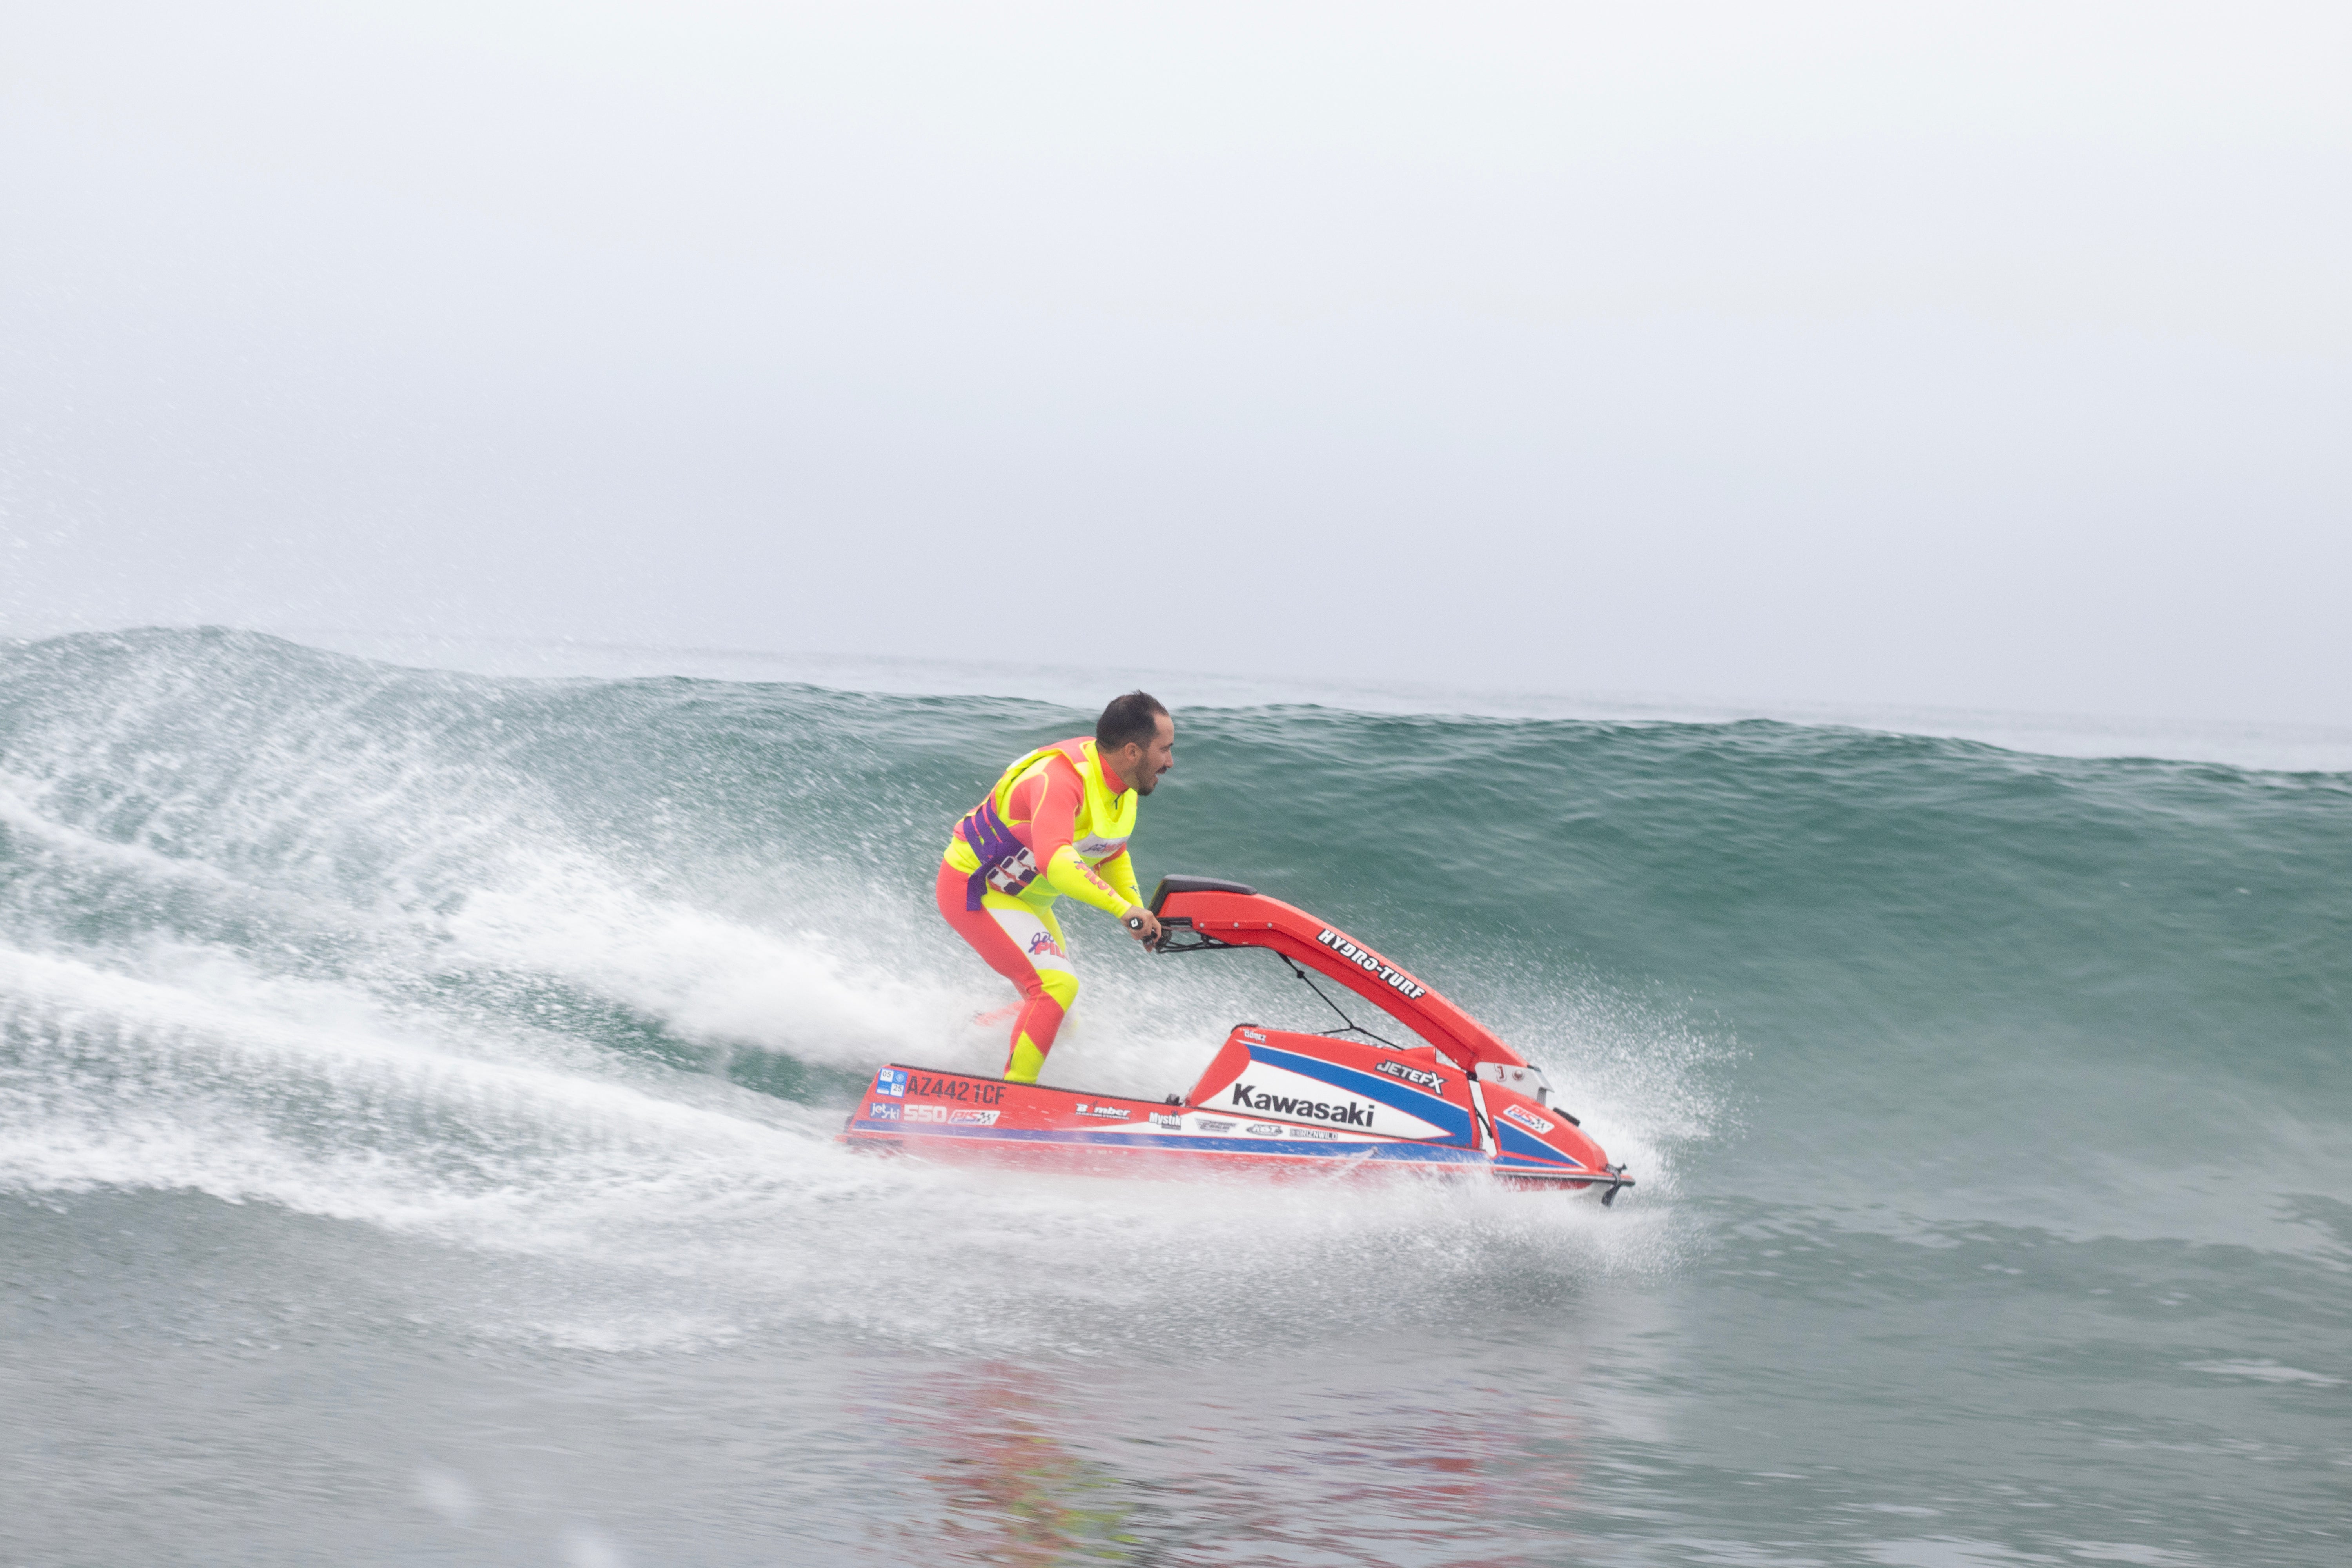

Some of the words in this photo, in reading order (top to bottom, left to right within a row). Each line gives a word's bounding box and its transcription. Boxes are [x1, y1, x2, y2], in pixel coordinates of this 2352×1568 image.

[1034, 941, 1069, 959] PIL
[1317, 929, 1426, 999] HYDRO-TURF
[906, 1076, 1006, 1105] AZ4421CF
[1375, 1060, 1446, 1095] JETEFX
[904, 1104, 947, 1123] 550
[1149, 1111, 1182, 1126] Mystik
[1232, 1083, 1375, 1127] Kawasaki
